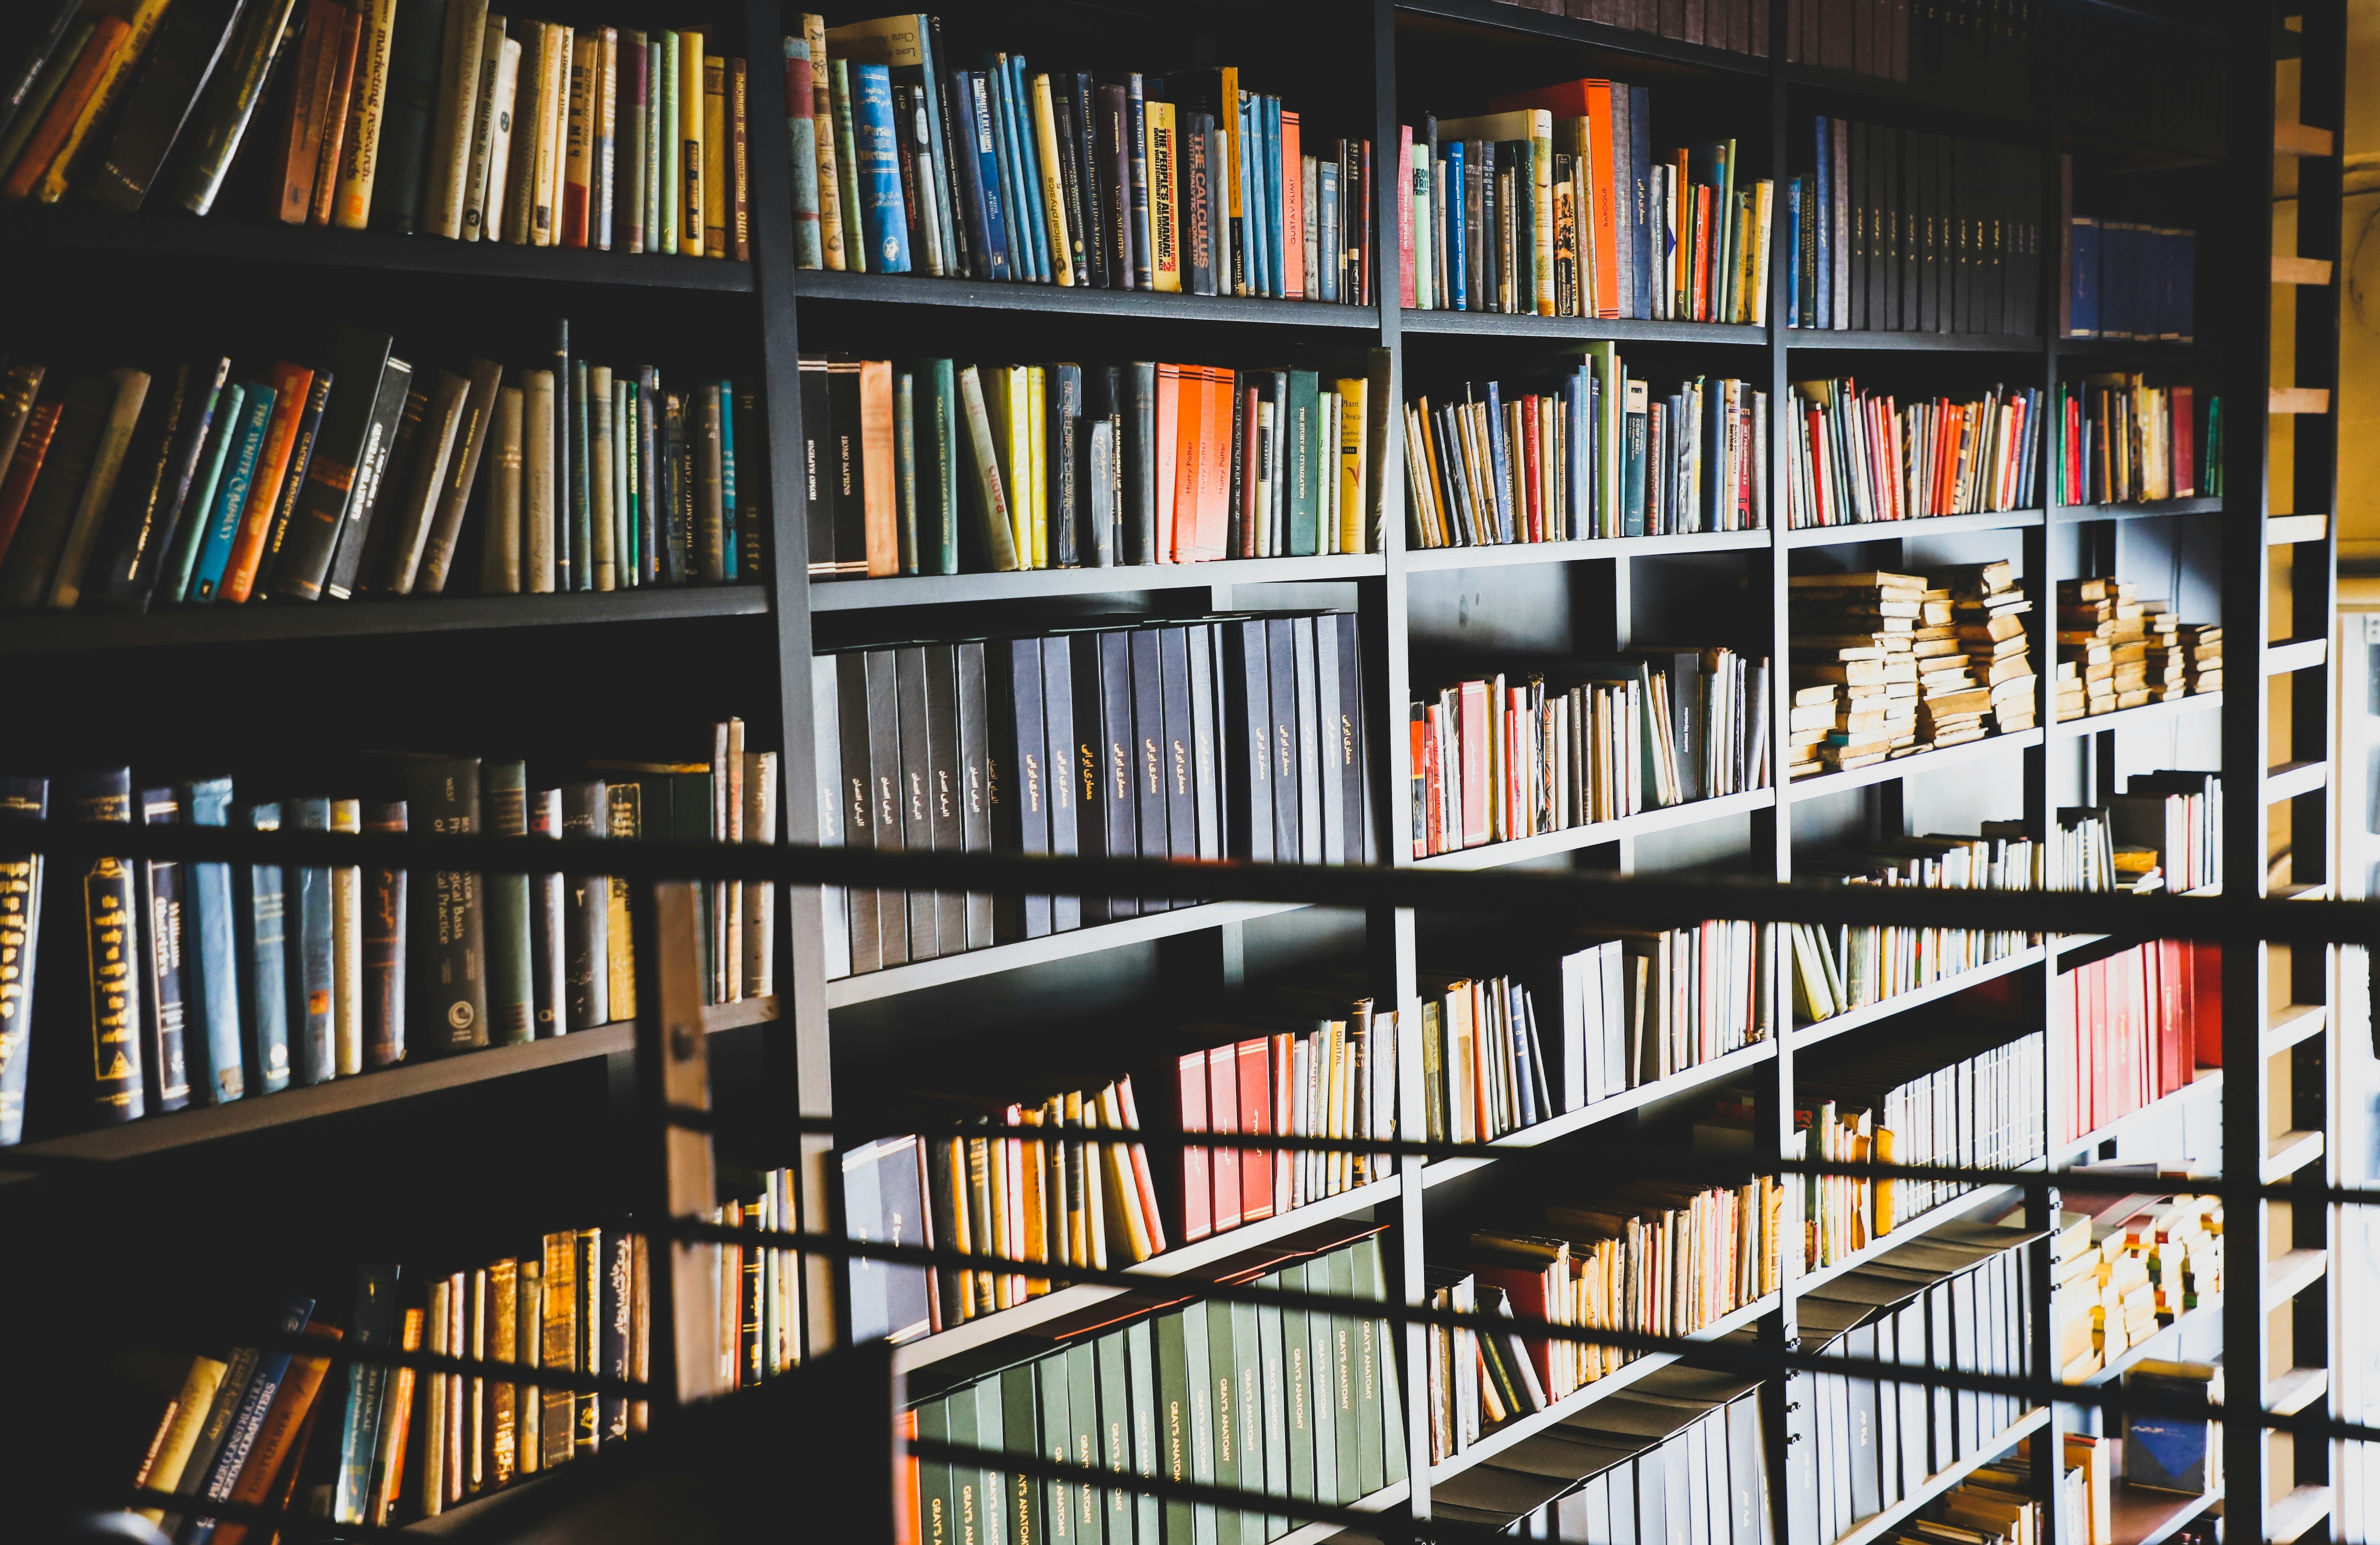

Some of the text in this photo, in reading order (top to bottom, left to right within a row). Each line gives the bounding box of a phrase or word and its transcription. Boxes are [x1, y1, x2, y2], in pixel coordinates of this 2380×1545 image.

[352, 82, 366, 111] and
[362, 28, 388, 183] marketing research:
[568, 66, 583, 157] ЩИТ И МЕЧ
[346, 117, 363, 180] methods
[477, 144, 485, 156] THE
[735, 73, 746, 203] ПРОИСХОДИЛО ЗА КУЛИСАМИ
[984, 128, 993, 153] EXAMPLE
[1087, 135, 1095, 164] Visual
[1048, 177, 1058, 218] physics
[1075, 185, 1083, 239] ORGANIZATION
[1159, 128, 1171, 272] THE PEOPLE'S ALMANAC 2
[1194, 133, 1209, 268] THE CALCULUS
[1328, 280, 1332, 288] LA
[1341, 399, 1359, 408] Plant
[237, 403, 269, 477] THE WHITE
[841, 435, 851, 496] HOMO SAPIENS
[1064, 381, 1073, 520] ENGINEERING DRAWING
[1299, 445, 1305, 454] OF
[1527, 440, 1535, 467] Napoleon
[282, 475, 301, 517] PROJECT
[807, 440, 817, 500] HOMO SAPIENS
[988, 465, 1005, 514] RADIO
[1185, 469, 1194, 494] Harry
[272, 519, 291, 553] PAPERS
[1146, 739, 1158, 793] معماری ایرانی
[1280, 725, 1291, 776] معماری ایرانی
[1342, 715, 1352, 765] معماری ایرانی
[1027, 754, 1039, 812] معماری ایرانی
[1080, 744, 1094, 800] معماری ایرانی
[1113, 743, 1126, 798] معماری ایرانی
[1173, 740, 1186, 795] معماری ایرانی
[440, 894, 450, 944] Practice
[455, 906, 465, 940] Basis
[1339, 1329, 1349, 1409] GRAY'S ANATOMY
[1362, 1321, 1372, 1400] GRAY'S ANATOMY
[1245, 1368, 1255, 1452] GRAY'S ANATOMY
[1293, 1348, 1303, 1430] GRAY'S ANATOMY
[1170, 1399, 1180, 1436] GRAY'S
[1220, 1378, 1230, 1462] GRAY'S ANATOMY
[962, 1485, 974, 1523] GRAY'S
[988, 1472, 999, 1510] GRAY'S
[1056, 1485, 1066, 1537] ANATOMY
[932, 1498, 943, 1537] GRAY'S
